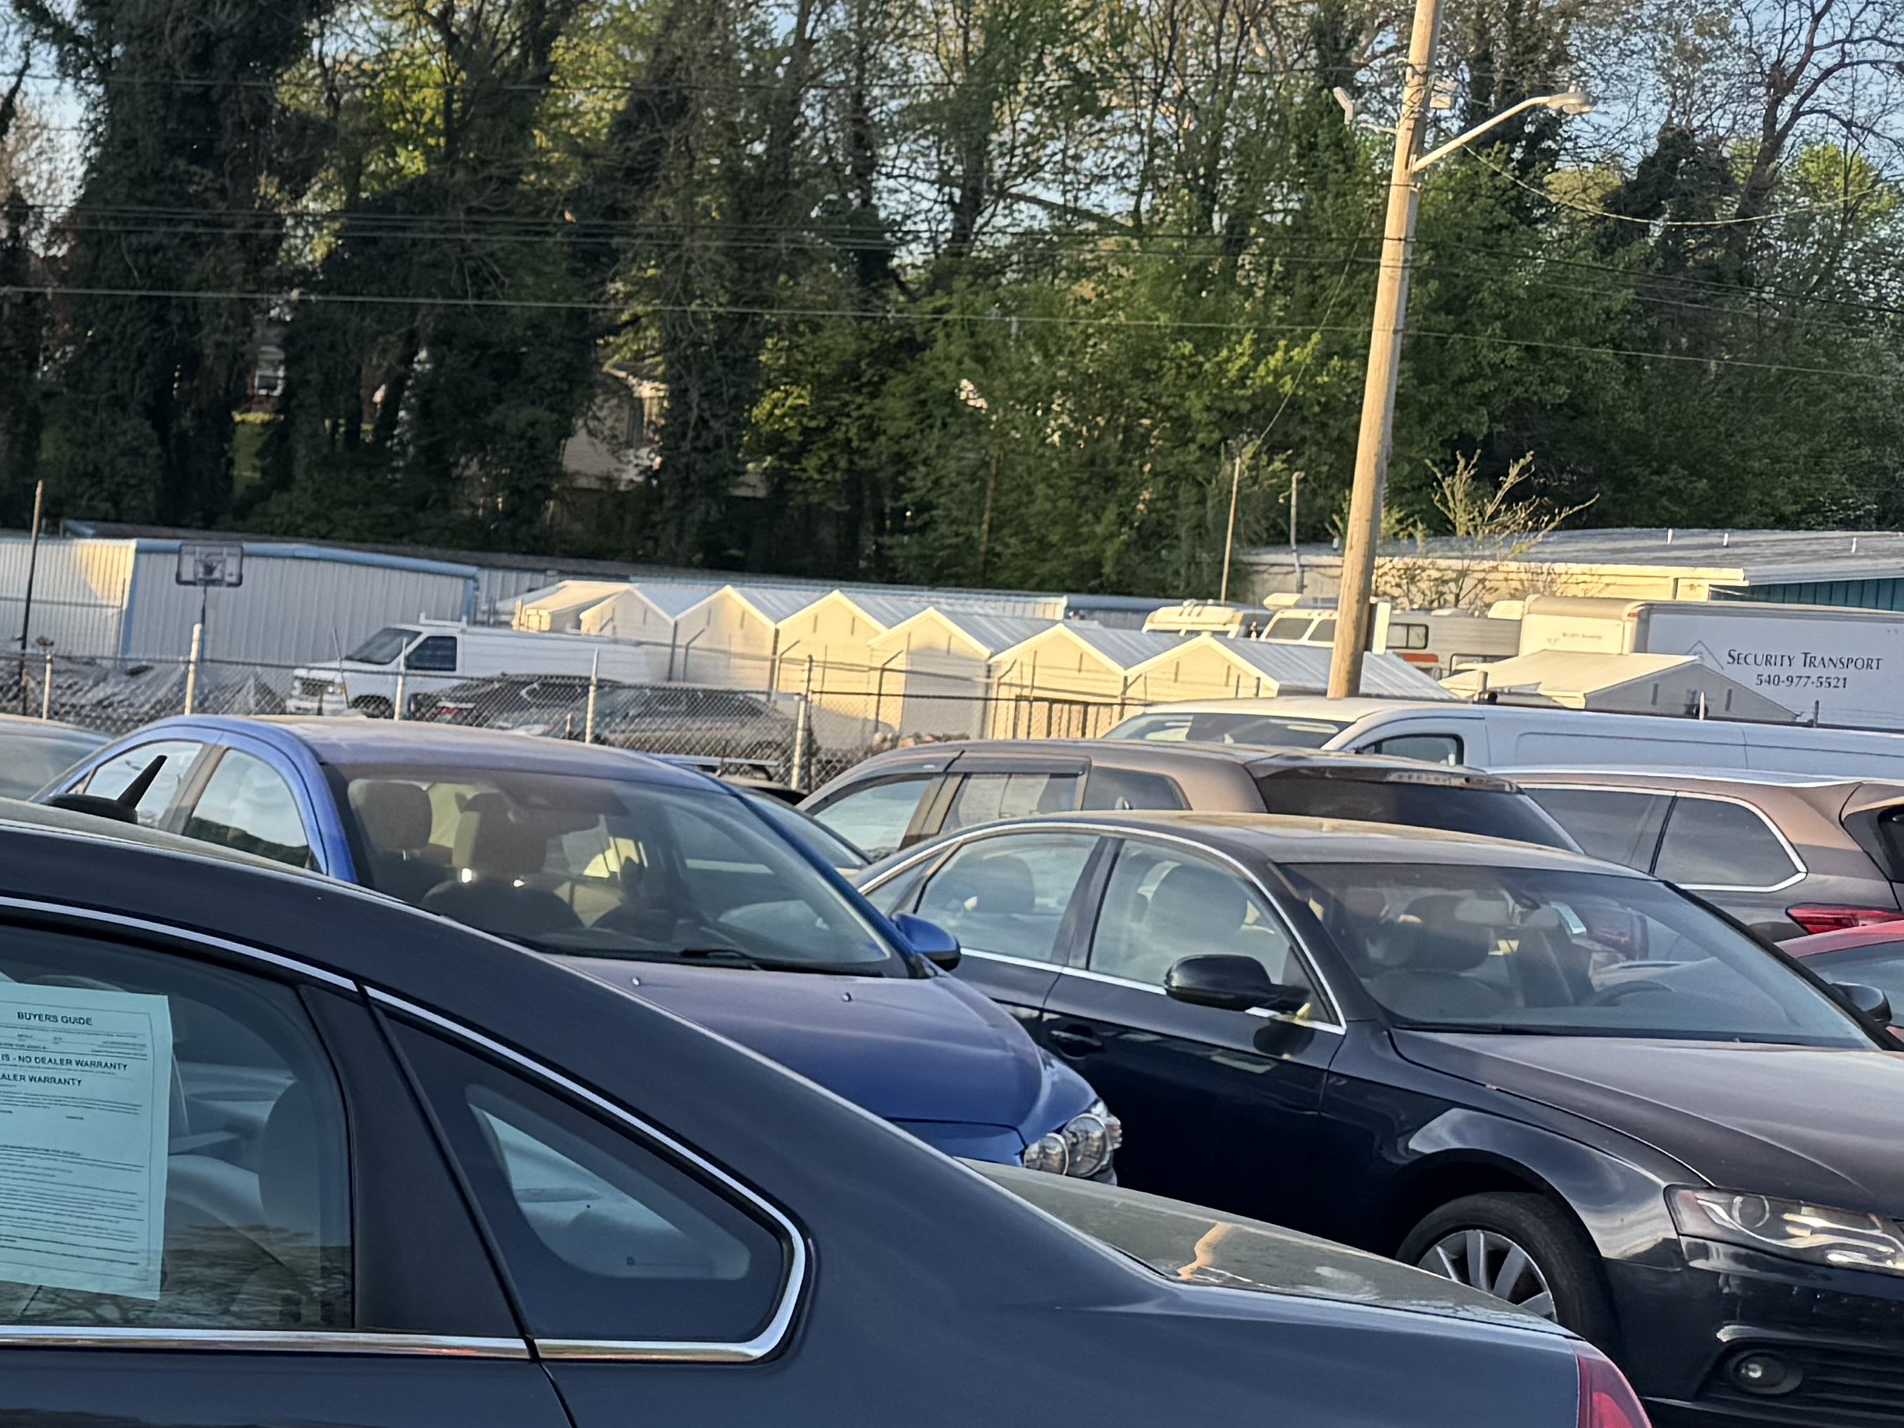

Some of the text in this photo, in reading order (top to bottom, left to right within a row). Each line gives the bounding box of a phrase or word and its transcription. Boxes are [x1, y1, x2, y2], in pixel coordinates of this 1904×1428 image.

[1727, 648, 1884, 671] SECURITY TRANSPORT
[1755, 673, 1848, 689] 540-977-5521
[17, 1010, 94, 1027] BUYERS GUIDE
[0, 1054, 10, 1062] IS
[18, 1055, 32, 1064] NO
[34, 1055, 73, 1067] DEALER
[75, 1058, 128, 1071] WARRANTY
[28, 1074, 82, 1087] WARRANTY
